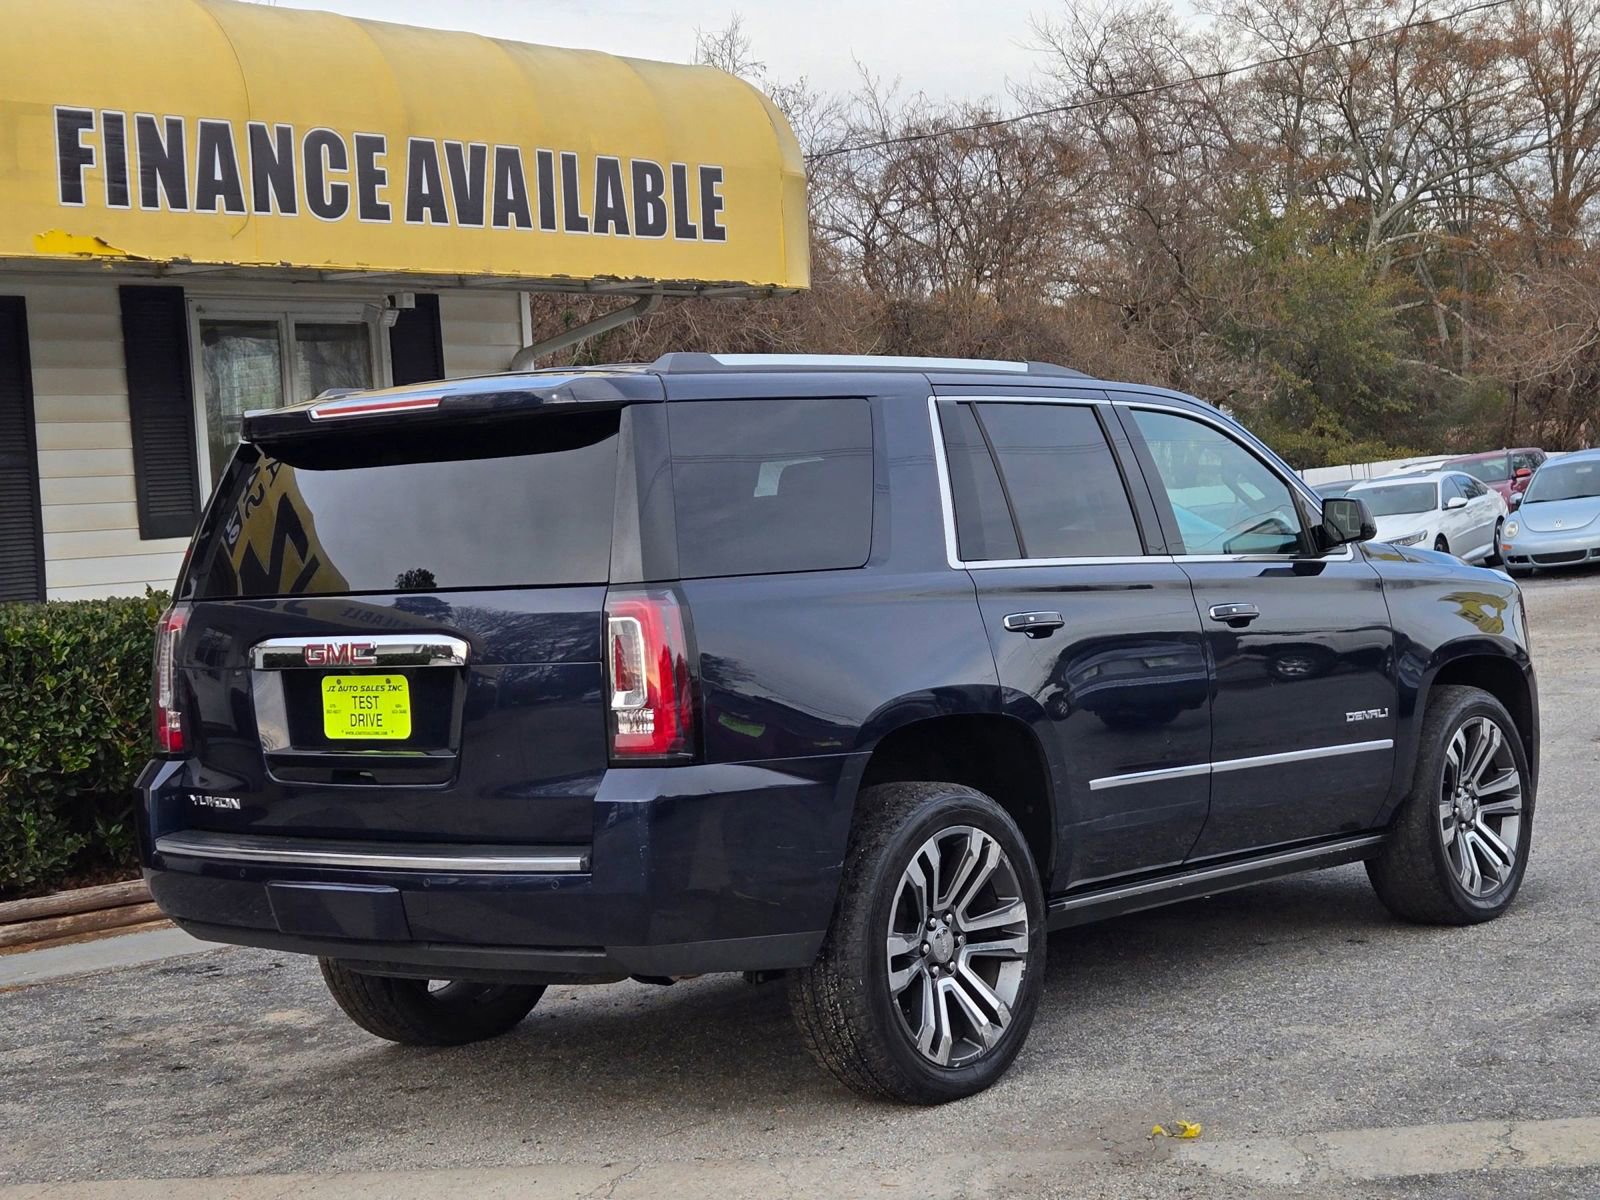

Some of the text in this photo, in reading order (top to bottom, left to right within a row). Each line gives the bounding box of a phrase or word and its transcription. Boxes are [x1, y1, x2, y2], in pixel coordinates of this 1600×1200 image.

[53, 105, 728, 243] FINANCE AVAILABLE
[304, 643, 377, 665] GMC
[351, 695, 379, 710] TEST
[350, 713, 383, 727] DRIVE
[1345, 707, 1389, 722] DENALI
